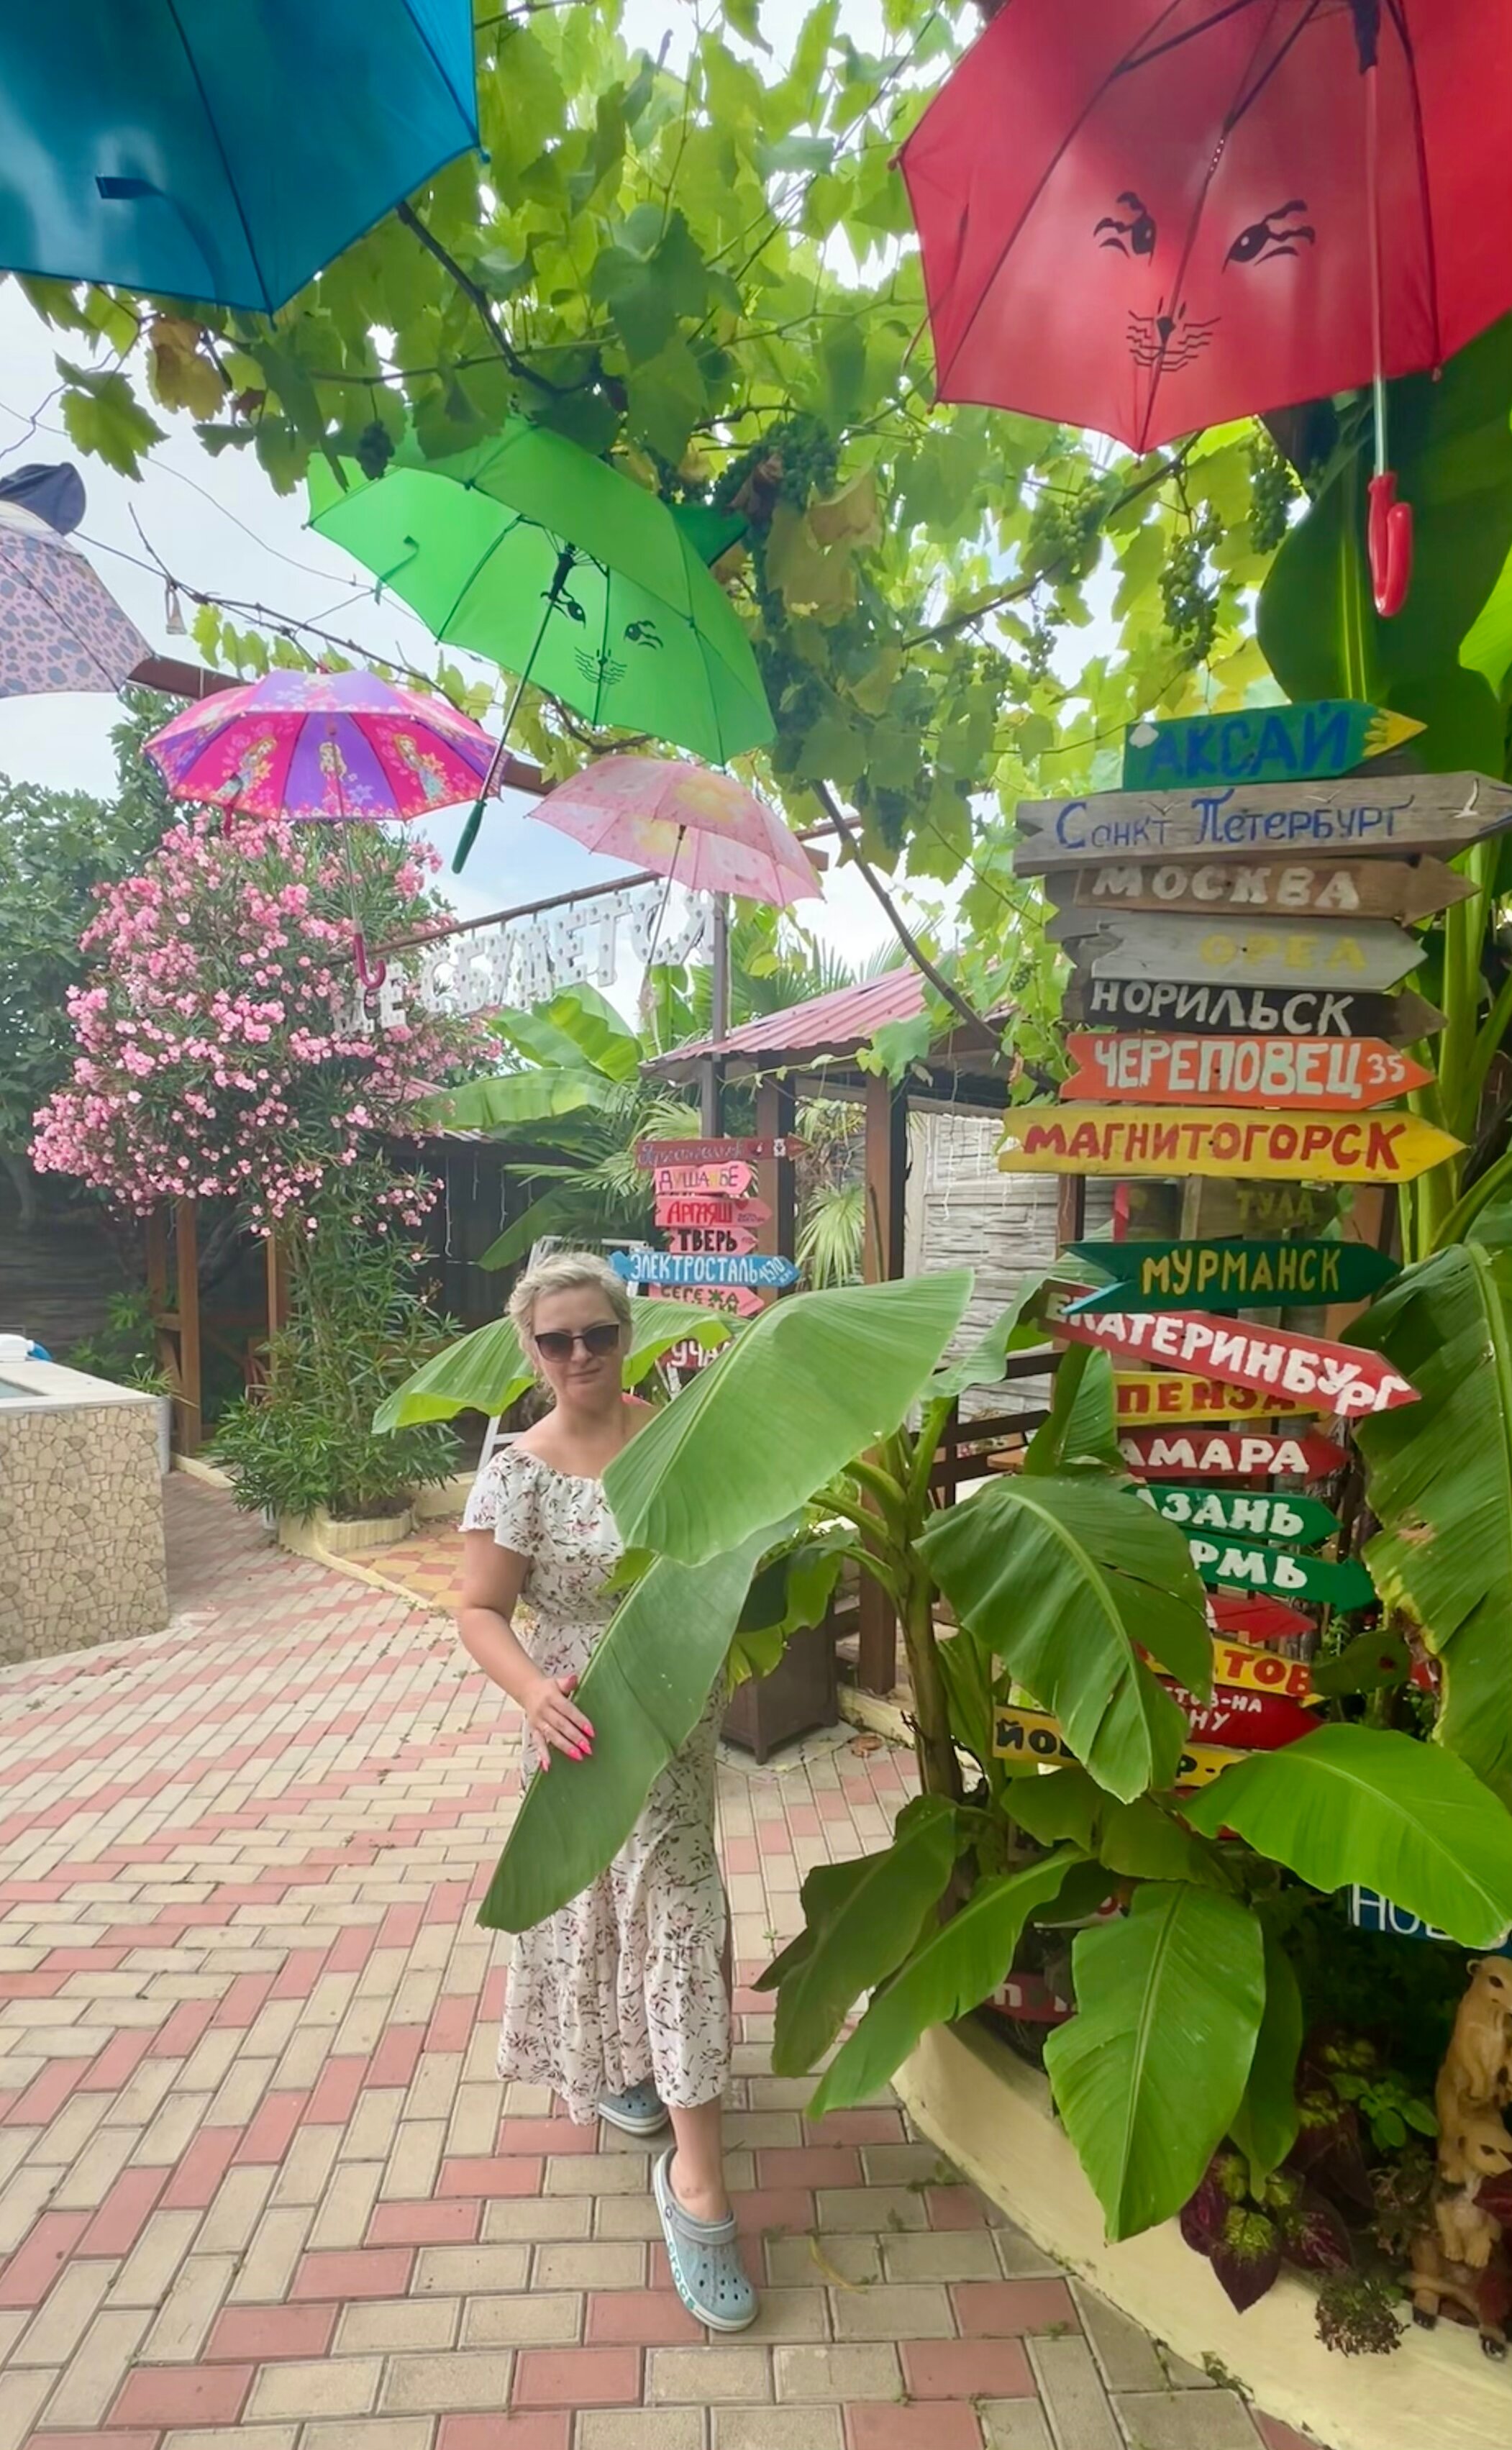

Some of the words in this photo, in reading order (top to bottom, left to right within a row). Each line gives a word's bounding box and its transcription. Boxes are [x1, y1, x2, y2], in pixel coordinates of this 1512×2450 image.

[1147, 701, 1351, 781] АКСАЙ
[1092, 866, 1360, 910] МОСКВА
[1090, 980, 1354, 1037] НОРИЛЬСК
[1095, 1039, 1363, 1099] ЧЕРЕПОВЕЦ
[1367, 1053, 1406, 1084] 35
[1024, 1121, 1407, 1170] МАГНИТОГОРСК
[1237, 1189, 1315, 1225] ТУЛА
[678, 1229, 737, 1252] ТВЕРЬ
[630, 1254, 758, 1284] ЭЛЕКТРОСТАЛЬ
[1142, 1247, 1342, 1296] МУРМАНСК
[1119, 1438, 1310, 1474] АМАРА
